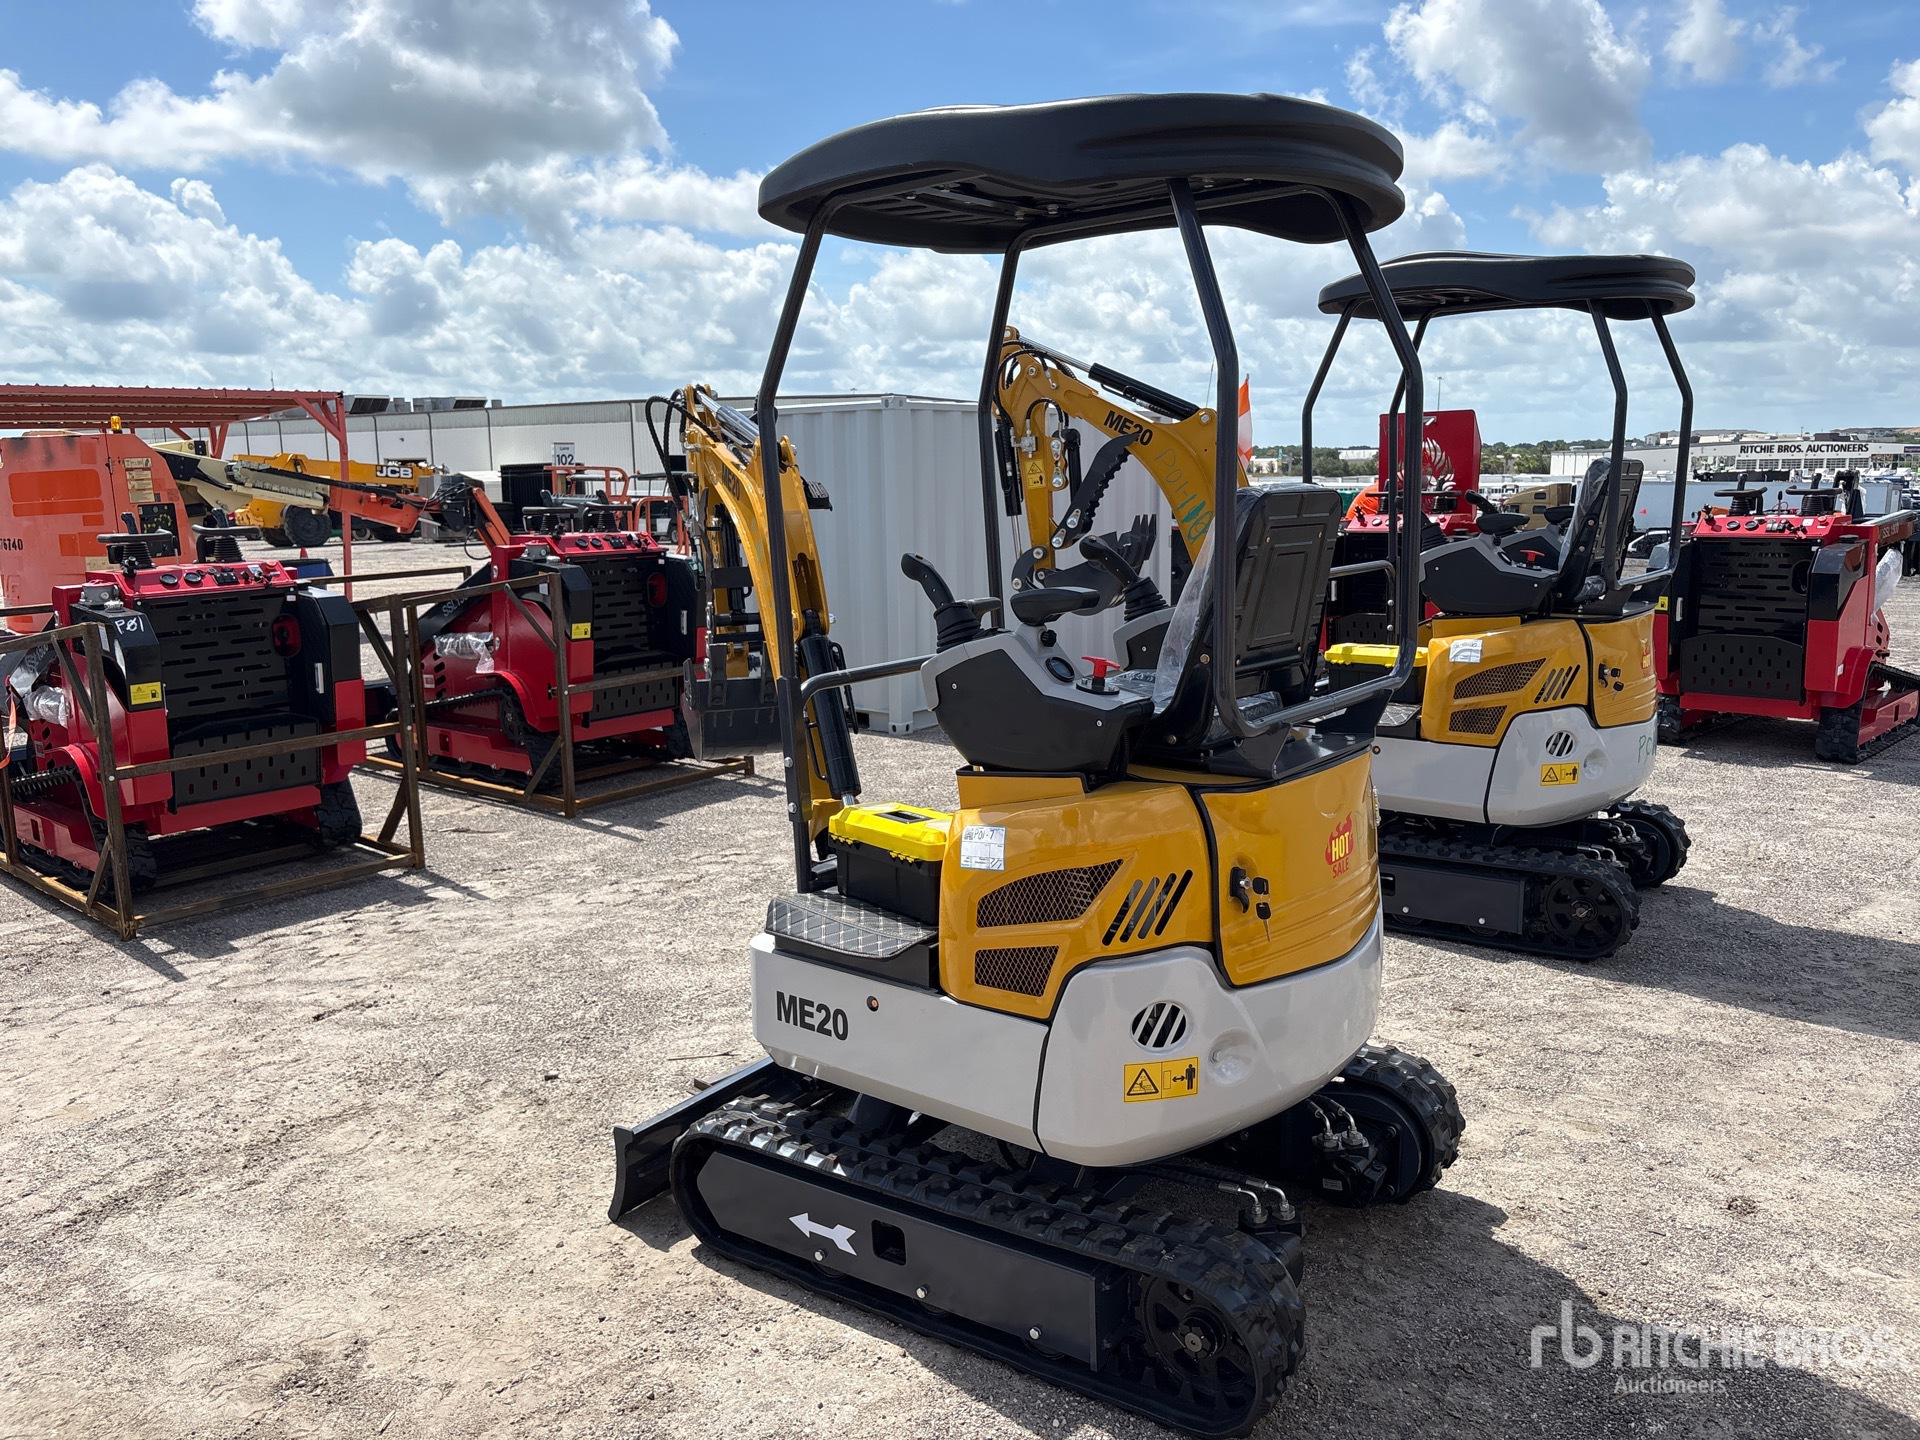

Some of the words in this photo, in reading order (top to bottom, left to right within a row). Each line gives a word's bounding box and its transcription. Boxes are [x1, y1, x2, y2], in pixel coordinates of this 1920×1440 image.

[1103, 410, 1154, 446] ME20
[1740, 444, 1775, 454] RITCHIE
[1777, 444, 1804, 453] BROS.
[1806, 443, 1869, 453] AUCTIONEERS
[556, 454, 575, 466] 102
[376, 465, 413, 478] JCB
[1331, 831, 1350, 863] HOT
[1332, 857, 1350, 879] SALE
[776, 990, 849, 1041] ME20
